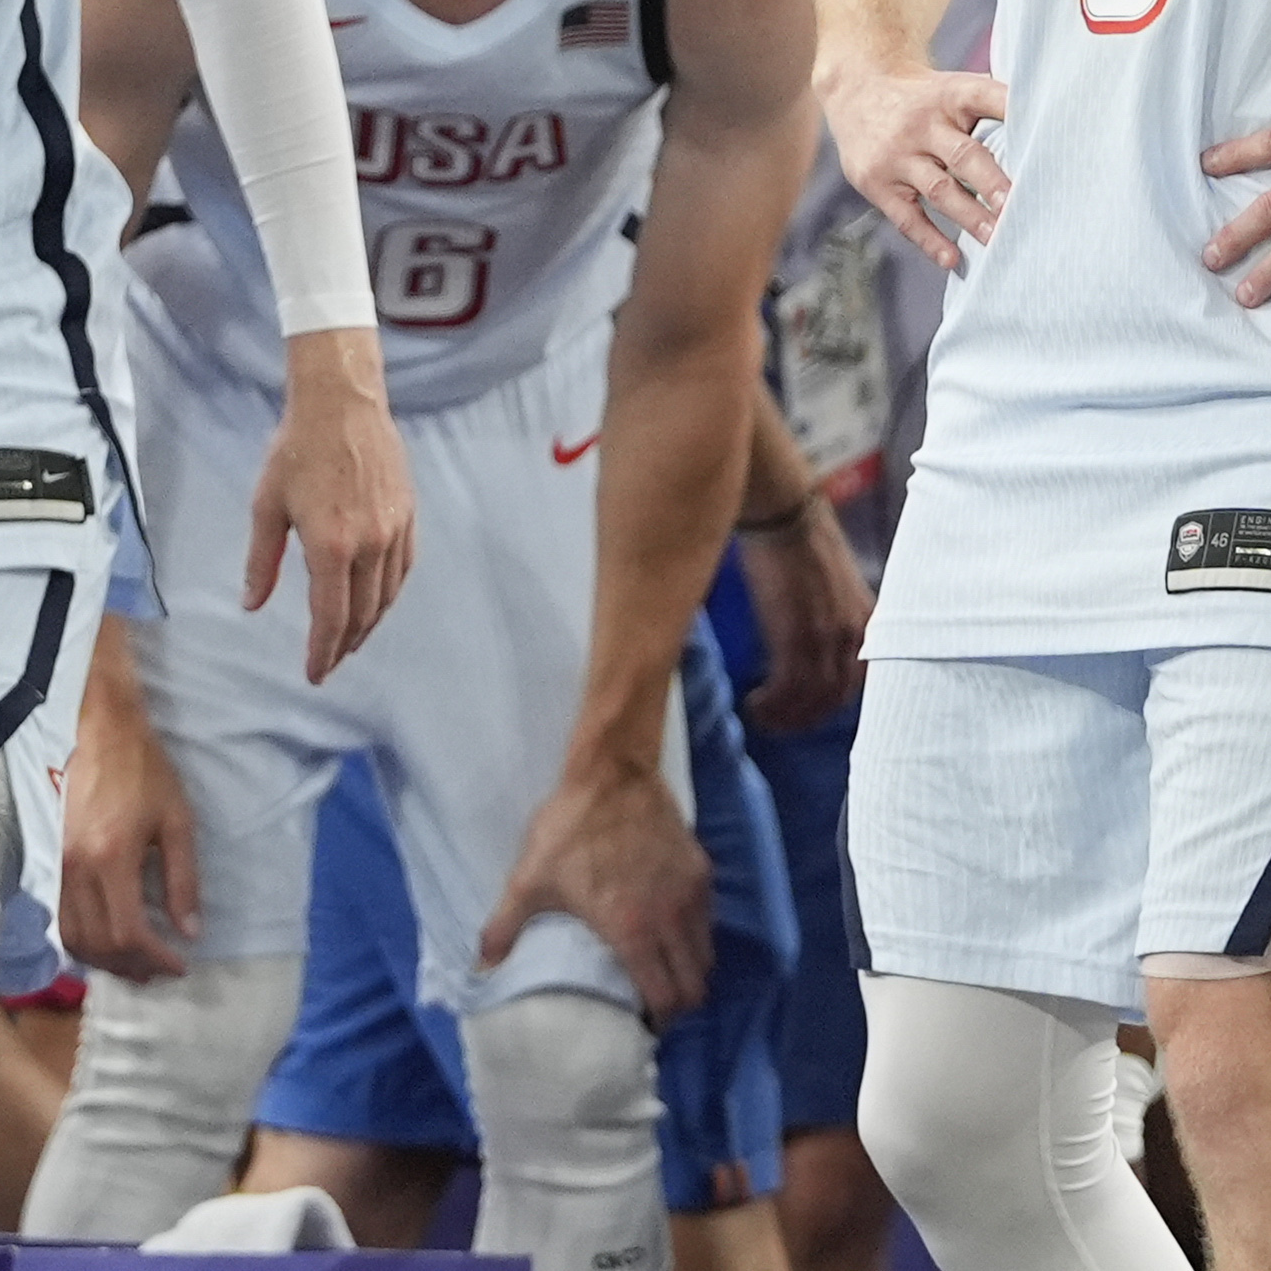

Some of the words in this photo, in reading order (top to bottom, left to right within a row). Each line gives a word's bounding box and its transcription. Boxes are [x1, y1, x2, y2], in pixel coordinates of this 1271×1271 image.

[355, 109, 566, 187] USA
[375, 218, 495, 328] 6
[1210, 532, 1229, 548] 46
